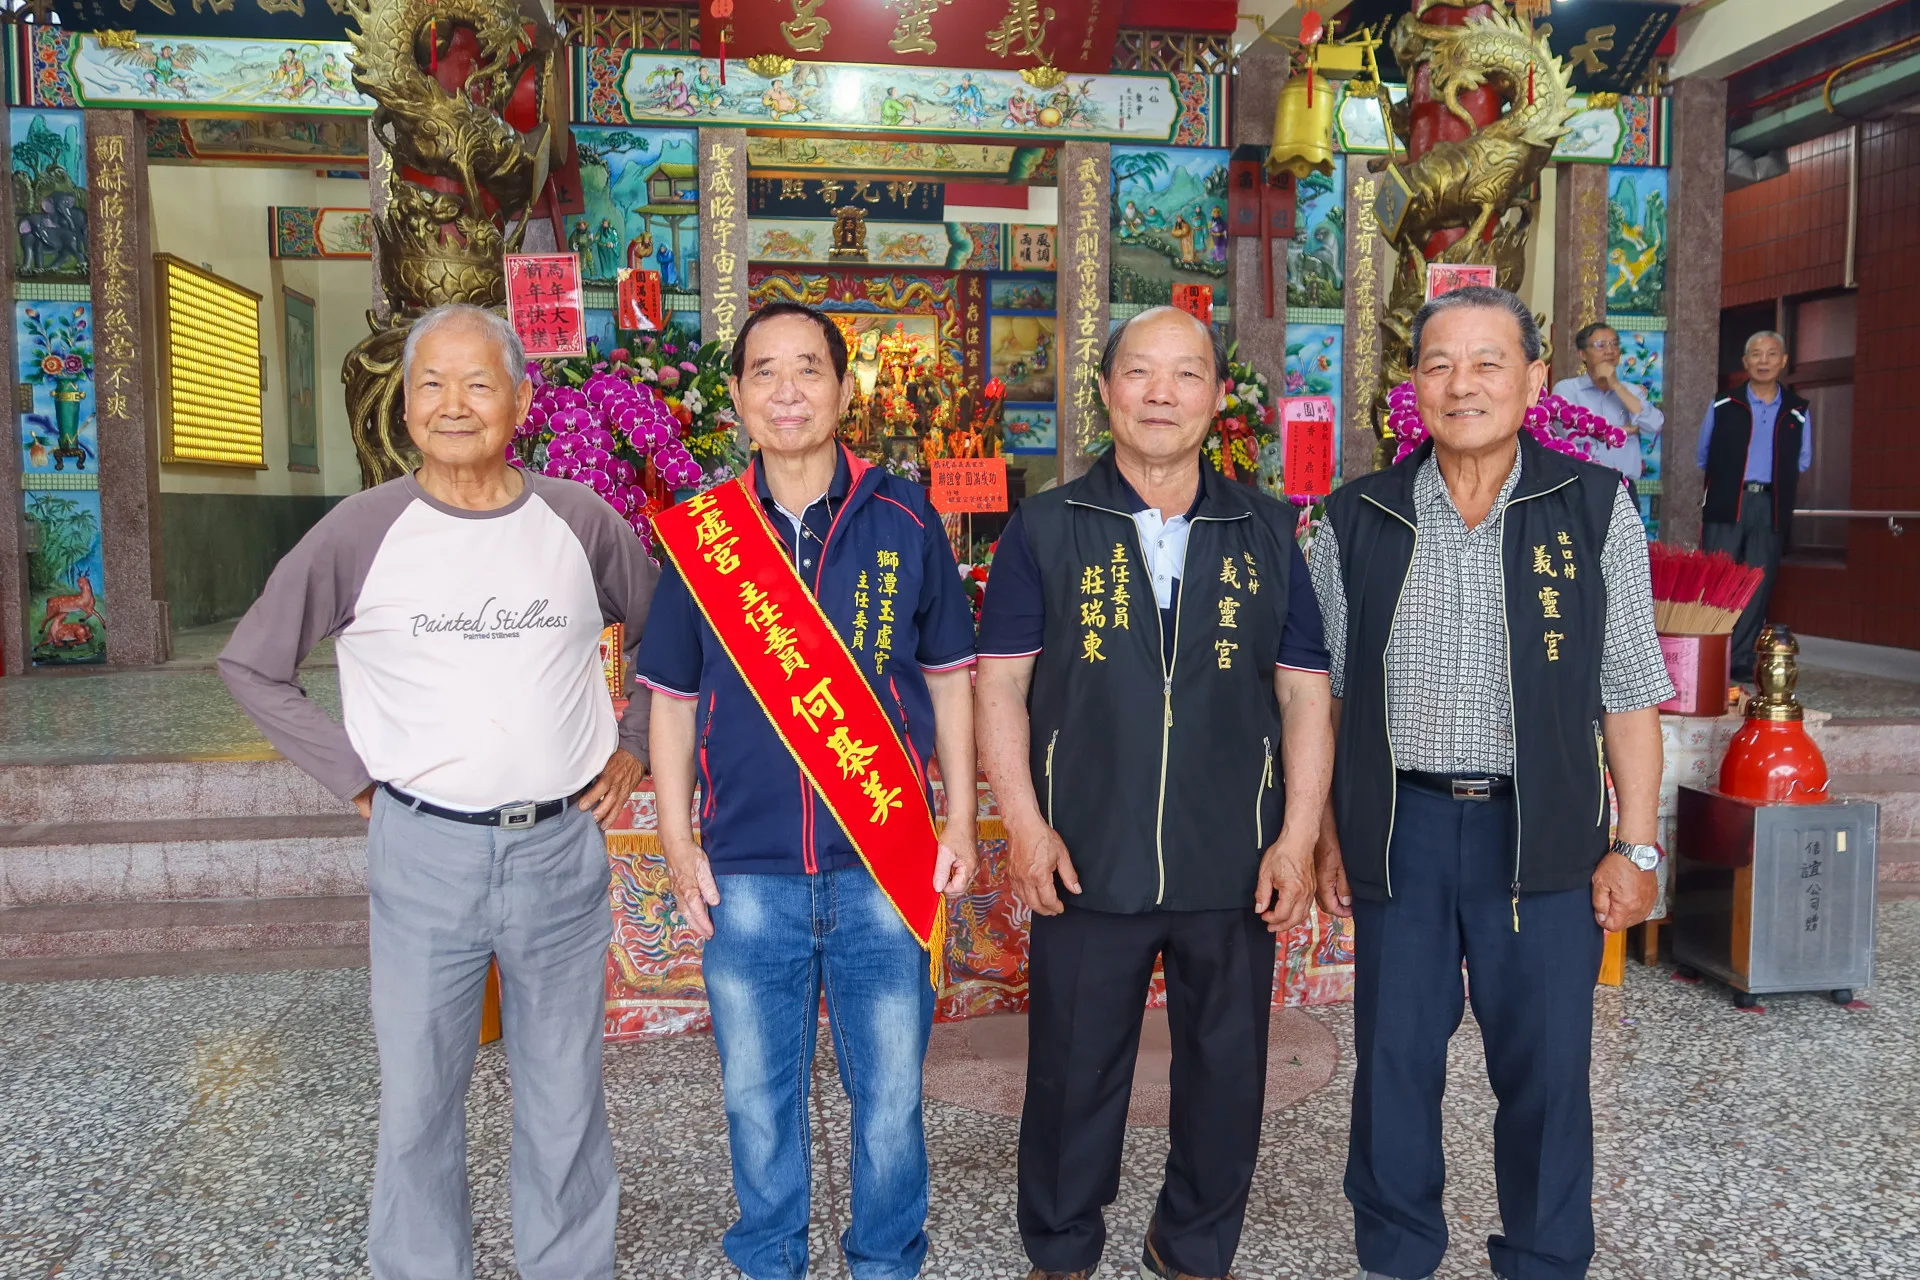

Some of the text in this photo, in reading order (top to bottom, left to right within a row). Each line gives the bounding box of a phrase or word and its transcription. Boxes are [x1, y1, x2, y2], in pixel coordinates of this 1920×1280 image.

[1020, 233, 1033, 263] 雨順
[1036, 233, 1051, 263] 風調
[523, 260, 548, 348] 新年快樂
[545, 259, 570, 347] 馬年大吉
[965, 471, 997, 486] 圓滿成功
[1303, 424, 1316, 492] 香火鼎盛
[686, 492, 741, 575] 玉虛宮
[410, 596, 568, 637] Painted Stillness
[738, 580, 810, 681] 主任委員
[851, 569, 871, 652] 主任委員
[873, 550, 900, 675] 獅潭玉虛宮
[1080, 565, 1107, 664] 莊瑞東
[1110, 542, 1131, 631] 主任委員
[1213, 556, 1242, 670] 義靈宮
[1532, 544, 1565, 662] 義靈宮
